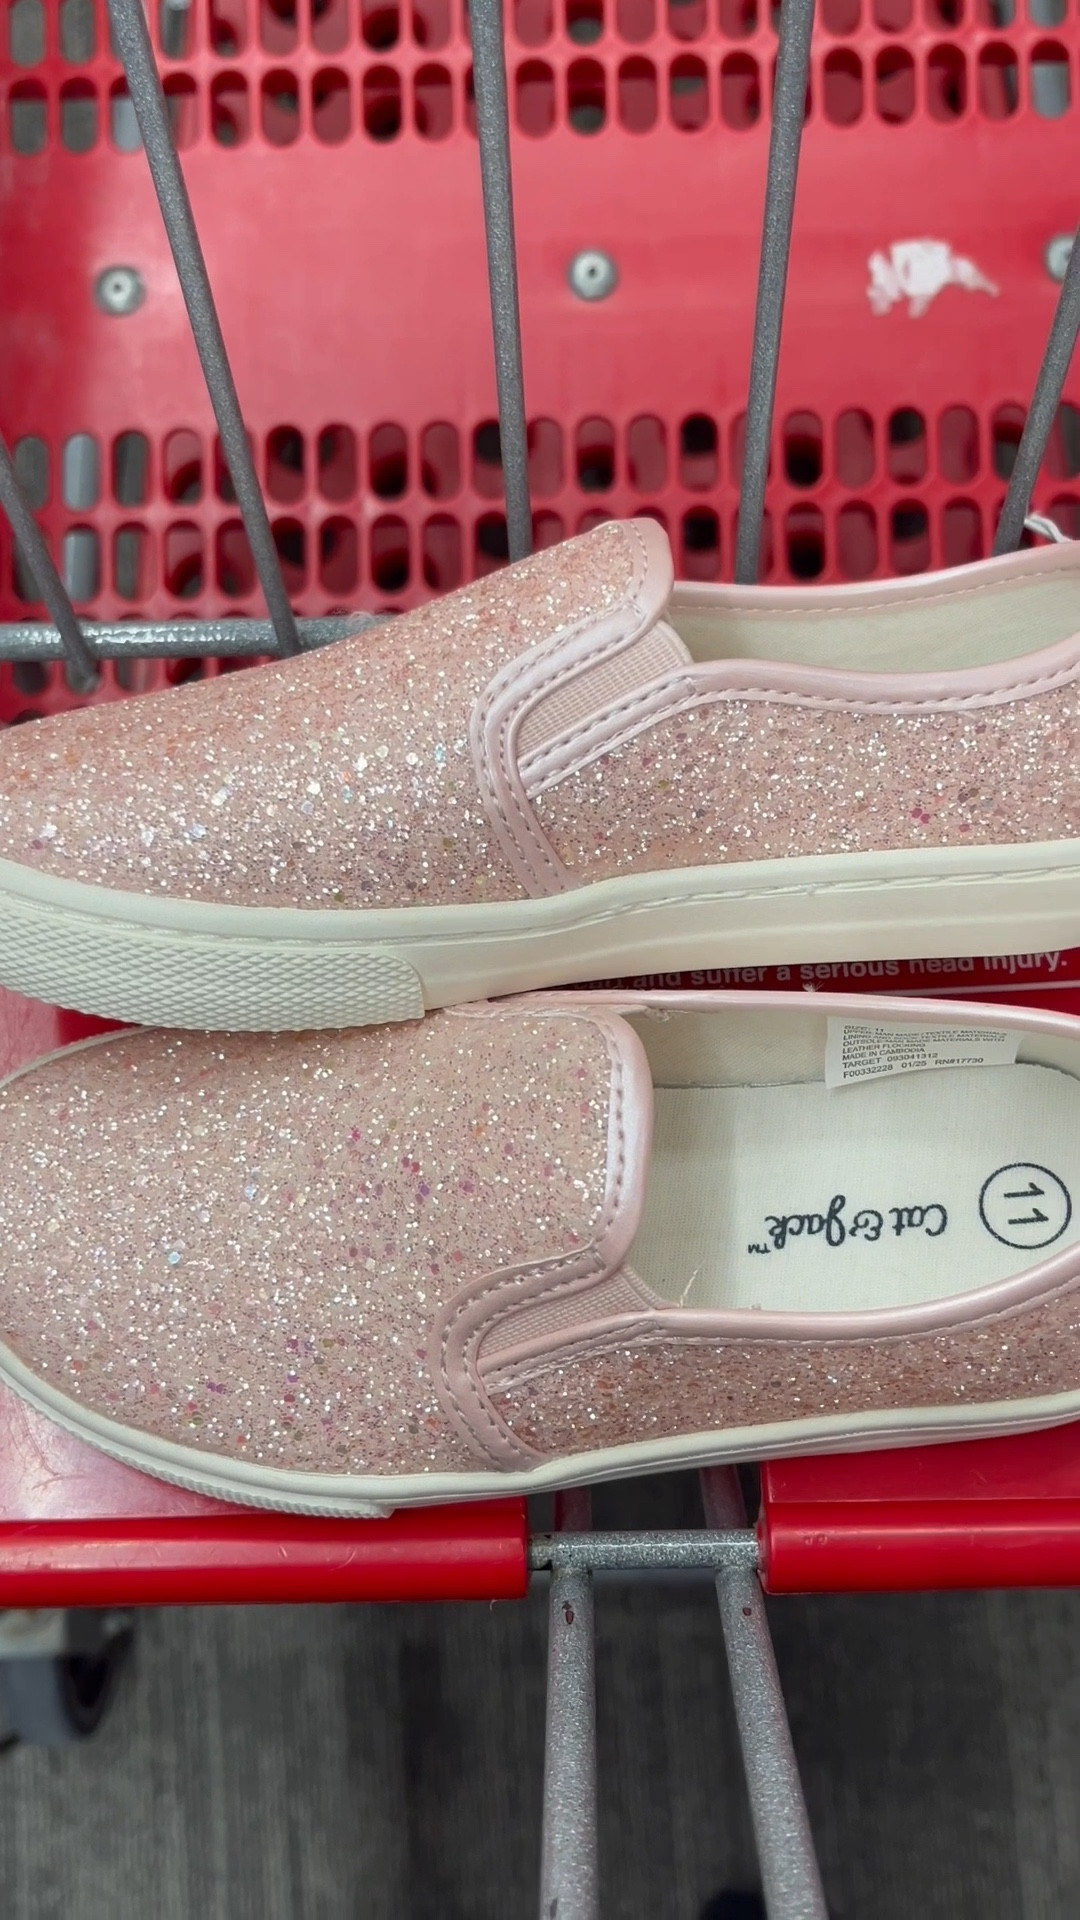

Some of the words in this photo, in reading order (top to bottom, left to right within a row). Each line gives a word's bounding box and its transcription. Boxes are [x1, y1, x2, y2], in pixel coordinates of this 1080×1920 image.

[633, 970, 681, 988] and
[691, 966, 767, 986] suffer
[777, 965, 790, 981] a
[801, 958, 899, 980] serious
[909, 956, 973, 975] head
[984, 951, 1067, 975] injury.
[842, 1044, 880, 1054] LEATHER
[842, 1052, 866, 1061] MADE
[879, 1047, 925, 1056] CAMBODIA
[842, 1057, 882, 1068] TARGET
[887, 1052, 938, 1062] 093041312
[843, 1064, 893, 1079] F00332228
[901, 1060, 927, 1069] 01/25
[934, 1057, 984, 1065] RN#17730
[1003, 1182, 1049, 1225] 11
[849, 1209, 884, 1241] &
[888, 1203, 947, 1237] Cat
